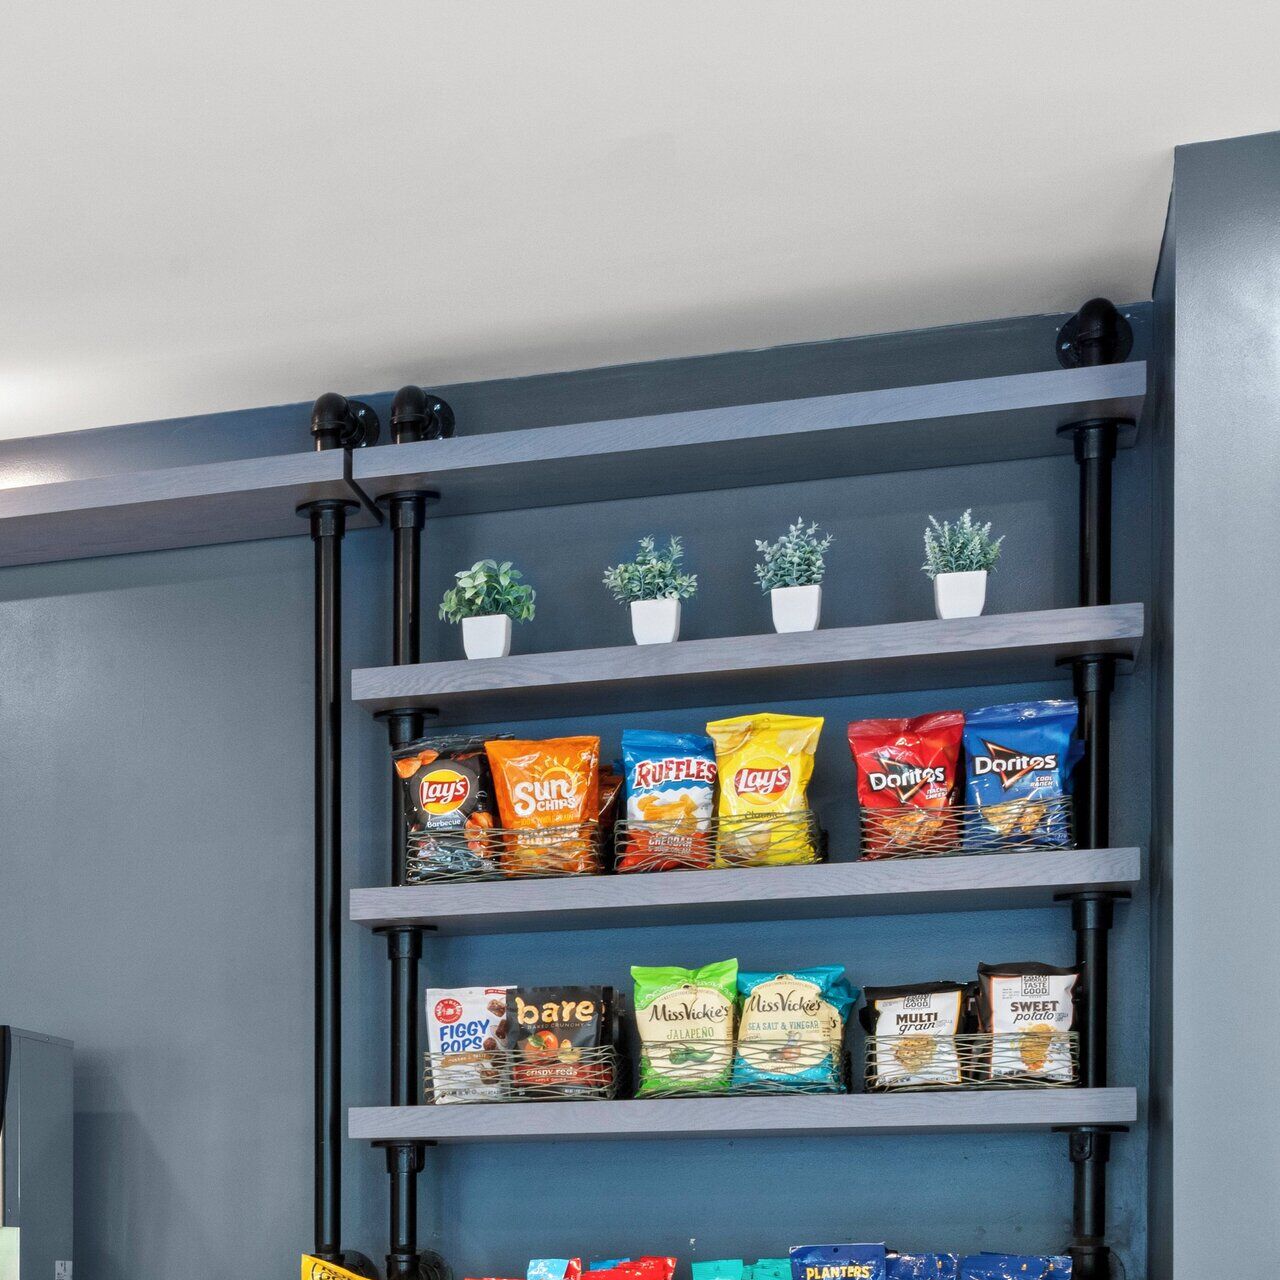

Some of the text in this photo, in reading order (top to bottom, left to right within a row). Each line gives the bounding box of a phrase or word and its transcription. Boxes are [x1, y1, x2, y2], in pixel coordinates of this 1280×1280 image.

[634, 757, 717, 789] RUFFLES
[975, 754, 1057, 775] Doritos
[738, 765, 789, 794] Lay's
[869, 767, 946, 791] Doritos
[422, 777, 468, 804] Lay's
[515, 778, 578, 817] Sun
[536, 797, 577, 810] CHIPS
[426, 819, 461, 829] Barbecue
[515, 995, 594, 1025] bare
[648, 999, 730, 1024] Miss Vickie's
[746, 990, 823, 1017] Miss Vickie's
[1010, 1000, 1059, 1013] SWEET
[748, 1020, 819, 1031] SEA SALT & VINEGAR
[896, 1012, 938, 1025] MULTI
[1013, 1011, 1055, 1024] potato
[440, 1019, 490, 1041] FIGGY
[666, 1026, 715, 1040] JALAPEÑO
[898, 1021, 936, 1035] grain
[440, 1036, 482, 1054] POPS
[806, 1265, 870, 1280] PLANTERS
